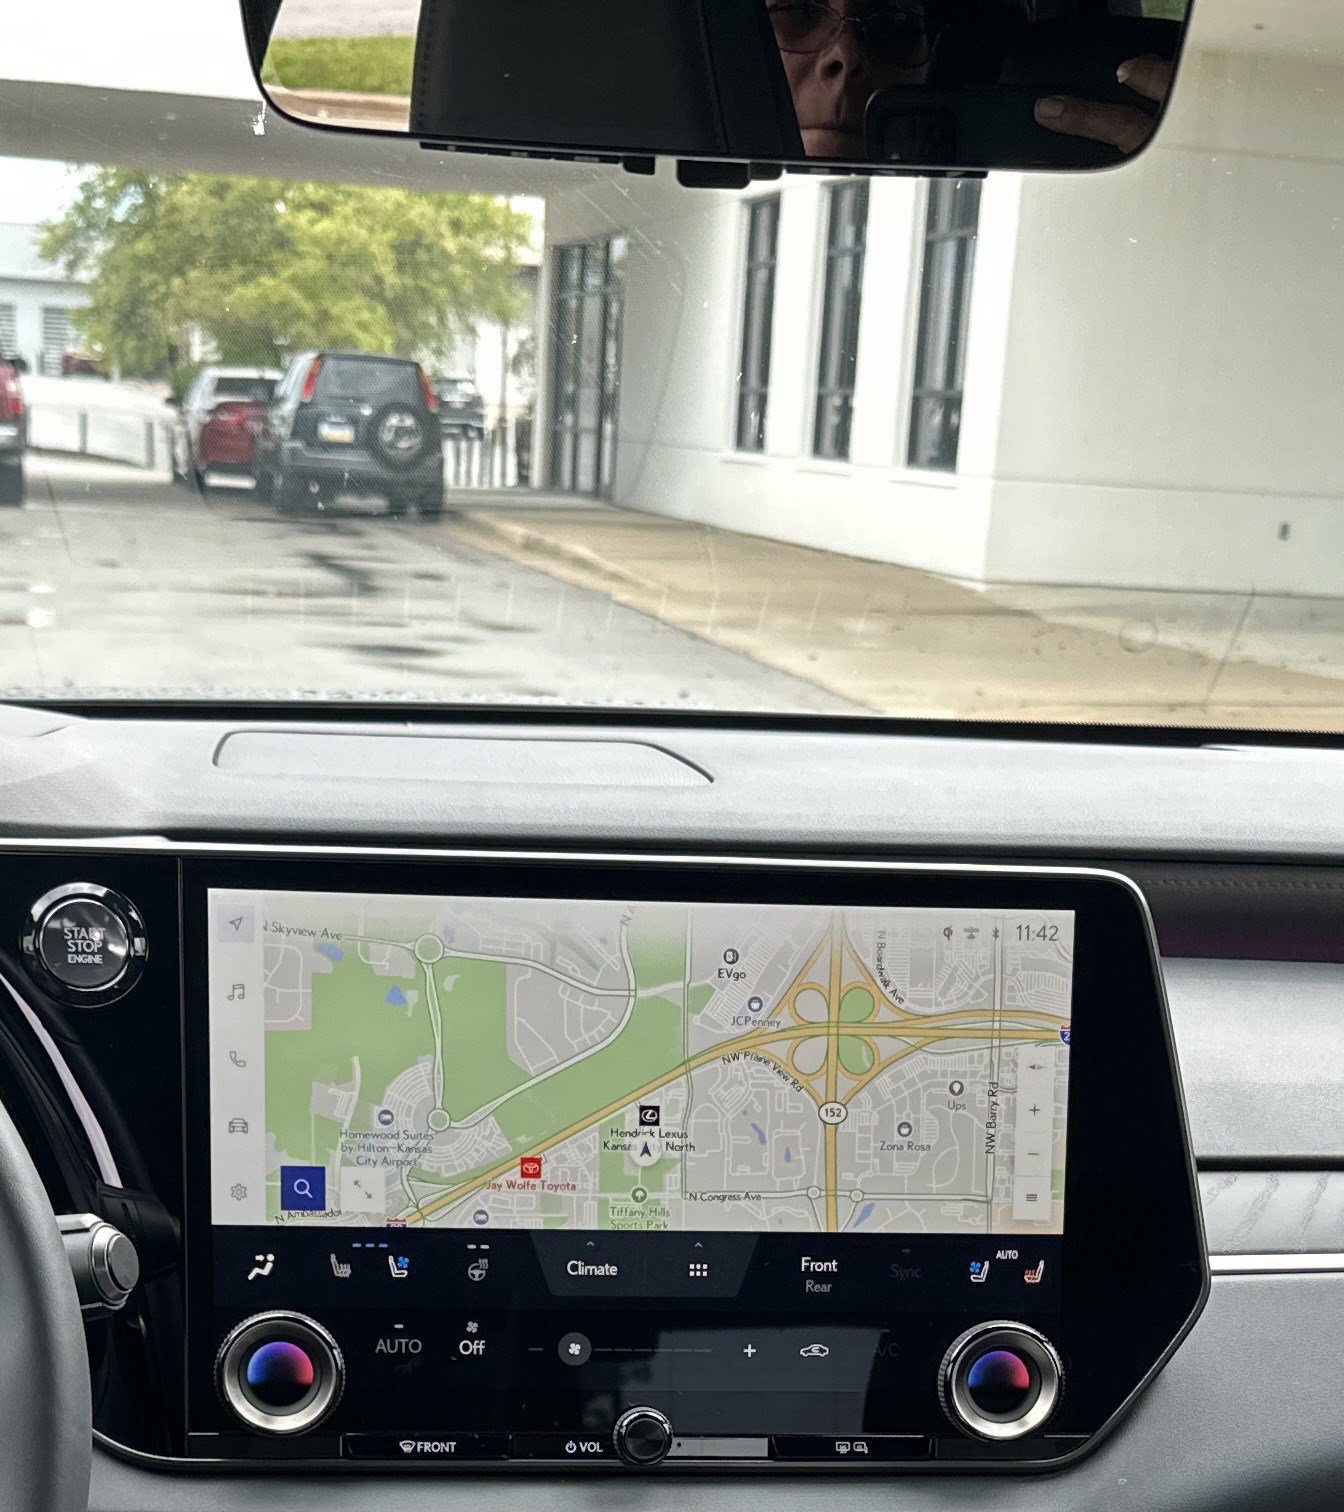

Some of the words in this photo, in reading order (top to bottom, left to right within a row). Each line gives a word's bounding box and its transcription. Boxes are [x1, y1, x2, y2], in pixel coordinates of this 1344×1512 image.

[64, 926, 106, 940] START
[269, 921, 317, 937] Skyview
[320, 927, 343, 940] Ave
[1016, 925, 1059, 942] 11:42
[67, 940, 103, 953] STOP
[67, 954, 104, 964] ENGINE
[717, 968, 746, 981] EVgo
[730, 1016, 782, 1028] JCPenney
[721, 1051, 740, 1066] NW
[789, 1078, 805, 1093] Rd
[987, 1081, 999, 1098] Rd
[947, 1100, 967, 1112] Ups
[824, 1107, 842, 1119] 152
[986, 1106, 1000, 1132] Barry
[339, 1129, 399, 1140] Homewood
[658, 1128, 689, 1139] Lexus
[341, 1144, 353, 1154] by
[603, 1140, 636, 1151] Kans
[665, 1141, 696, 1152] North
[880, 1142, 904, 1152] Zona
[906, 1142, 931, 1152] Rosa
[985, 1134, 997, 1154] NW
[356, 1157, 378, 1168] City
[381, 1157, 418, 1168] Airport
[486, 1181, 502, 1192] Jay
[506, 1180, 536, 1191] Wolfe
[541, 1181, 576, 1192] Toyota
[689, 1192, 697, 1201] N
[700, 1192, 743, 1203] Congress
[744, 1192, 761, 1201] Ave
[610, 1206, 645, 1220] Tiffany
[649, 1206, 671, 1218] Hills
[275, 1214, 285, 1225] N
[611, 1219, 643, 1231] Sports
[646, 1219, 669, 1230] Park
[995, 1250, 1019, 1261] AUTO
[566, 1260, 618, 1276] Climate
[801, 1256, 838, 1273] Front
[889, 1263, 922, 1281] Sync
[805, 1279, 832, 1293] Rear
[375, 1338, 423, 1355] AUTO
[459, 1340, 486, 1356] Off
[416, 1441, 457, 1453] FRONT
[579, 1441, 604, 1453] VOL
